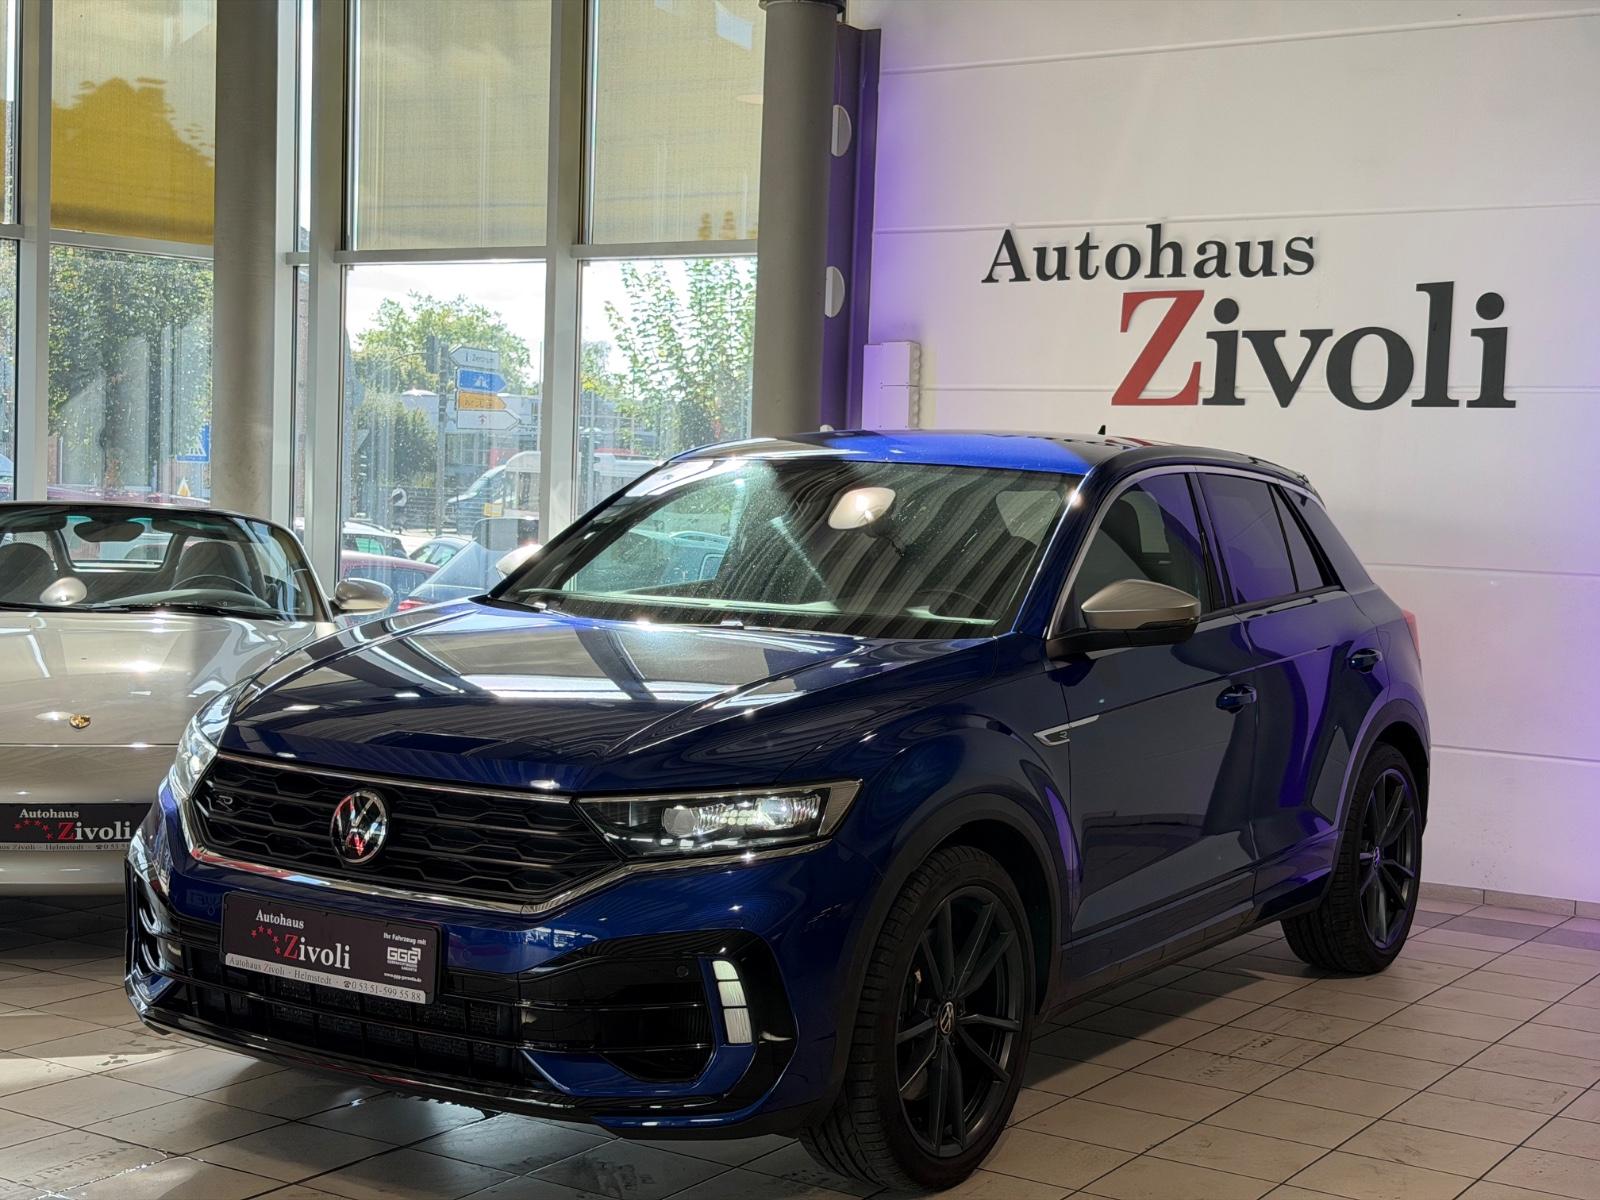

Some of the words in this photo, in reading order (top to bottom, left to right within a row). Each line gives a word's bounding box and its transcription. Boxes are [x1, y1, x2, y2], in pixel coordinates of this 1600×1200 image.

[981, 223, 1316, 284] Autohaus
[1111, 281, 1517, 411] Zivoli
[19, 808, 80, 819] Autohaus
[57, 821, 132, 840] Zivoli
[255, 908, 305, 929] Autohaus
[392, 933, 416, 945] Fahrzeug
[283, 932, 351, 970] Zivoli
[387, 945, 420, 965] GGG
[230, 956, 261, 970] Autohaus
[263, 962, 285, 975] Zivoli
[294, 969, 332, 985] Helmstedt
